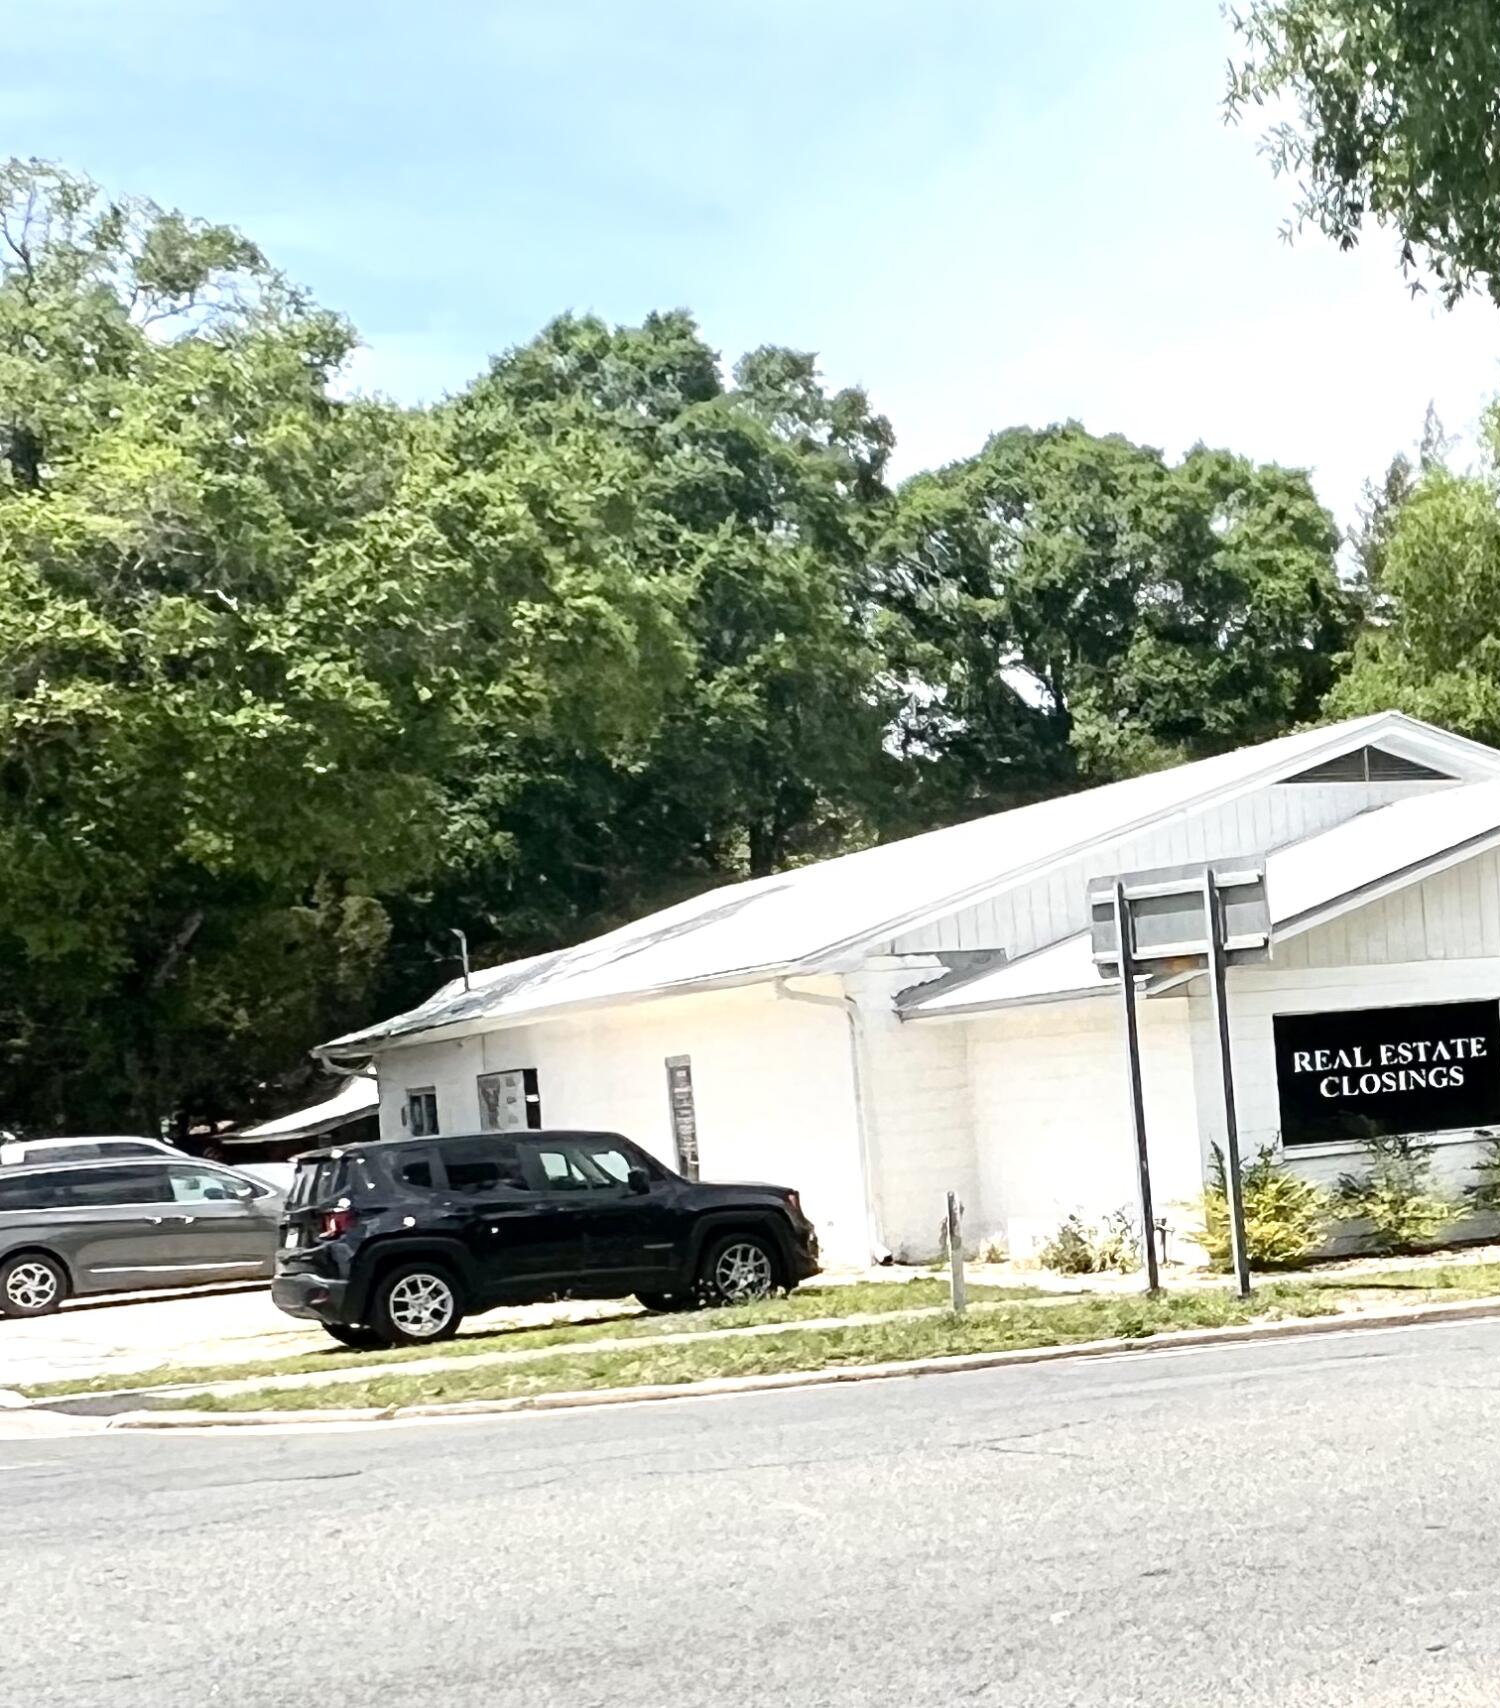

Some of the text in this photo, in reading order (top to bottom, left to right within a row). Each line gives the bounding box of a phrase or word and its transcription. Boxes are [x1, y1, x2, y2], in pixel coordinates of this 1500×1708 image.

[1293, 1037, 1488, 1073] REAL ESTATE
[1319, 1065, 1465, 1098] CLOSINGS
